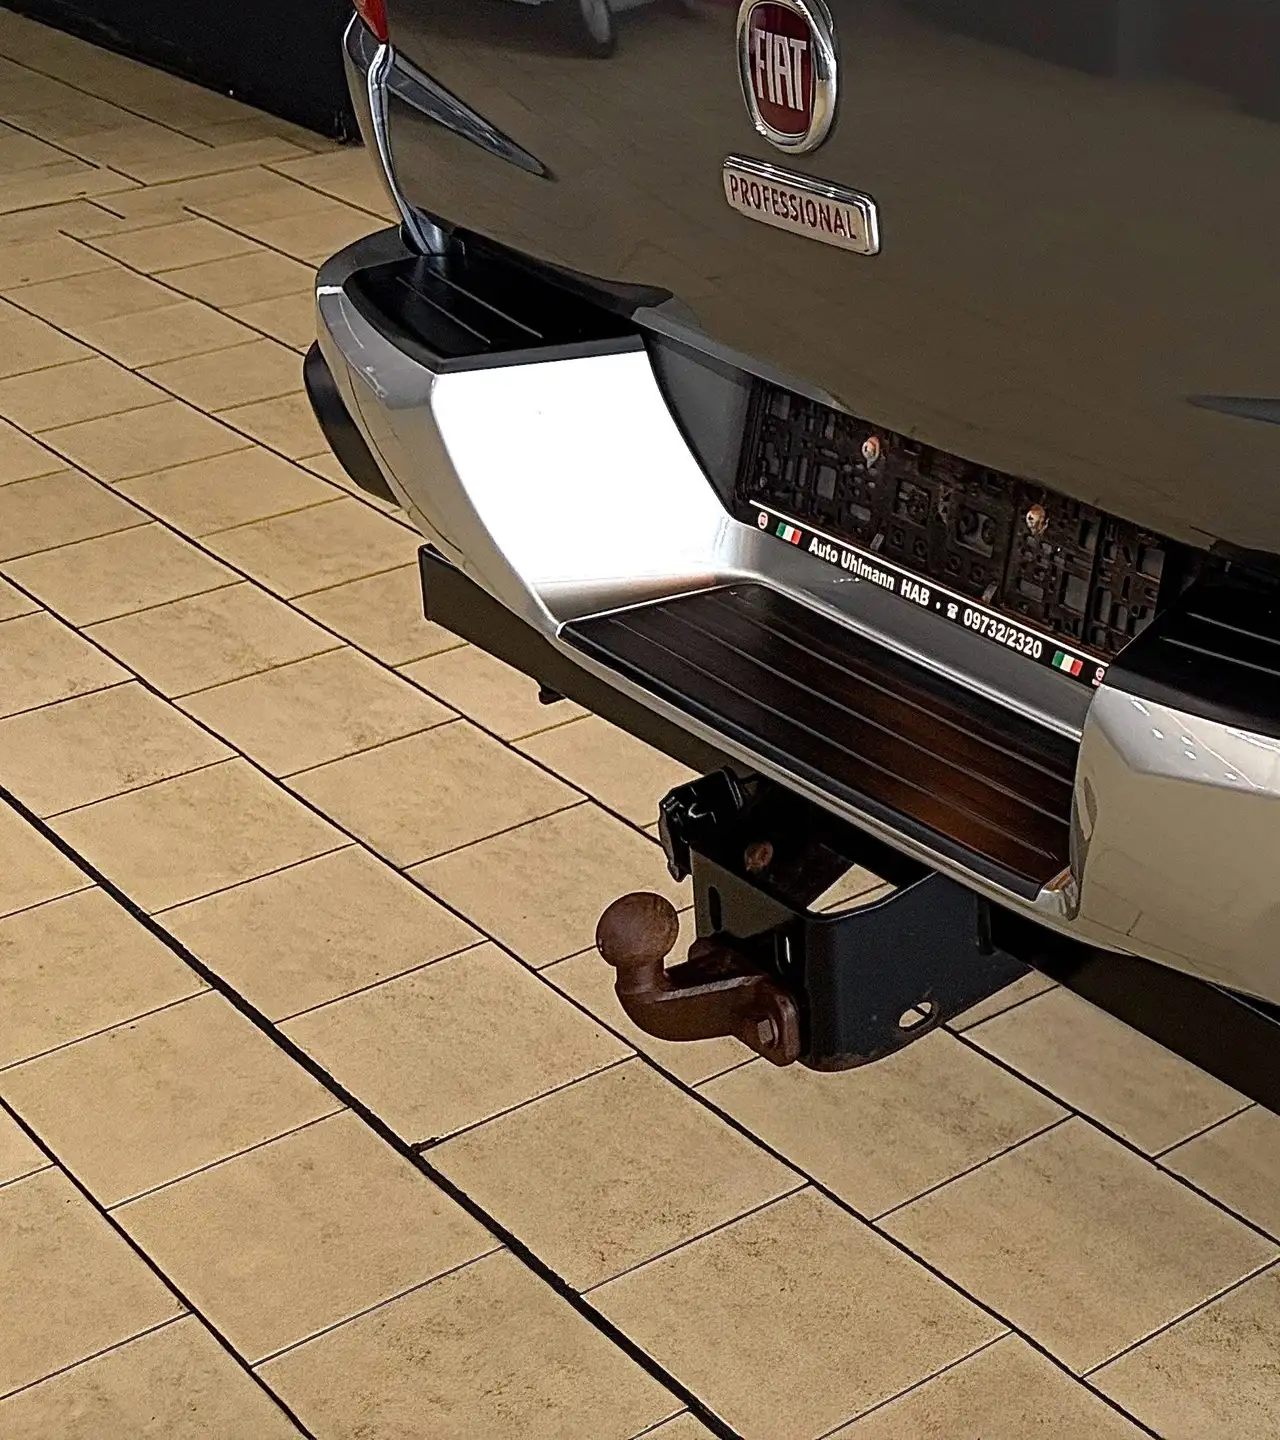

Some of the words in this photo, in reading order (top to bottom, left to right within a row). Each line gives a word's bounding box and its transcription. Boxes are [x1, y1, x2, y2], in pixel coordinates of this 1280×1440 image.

[754, 27, 807, 111] FIAT
[728, 173, 857, 240] PROFESSIONAL
[808, 536, 838, 563] Auto
[840, 550, 896, 591] Uhlmann
[900, 578, 930, 607] HAB
[963, 608, 1043, 659] 09732/2320
